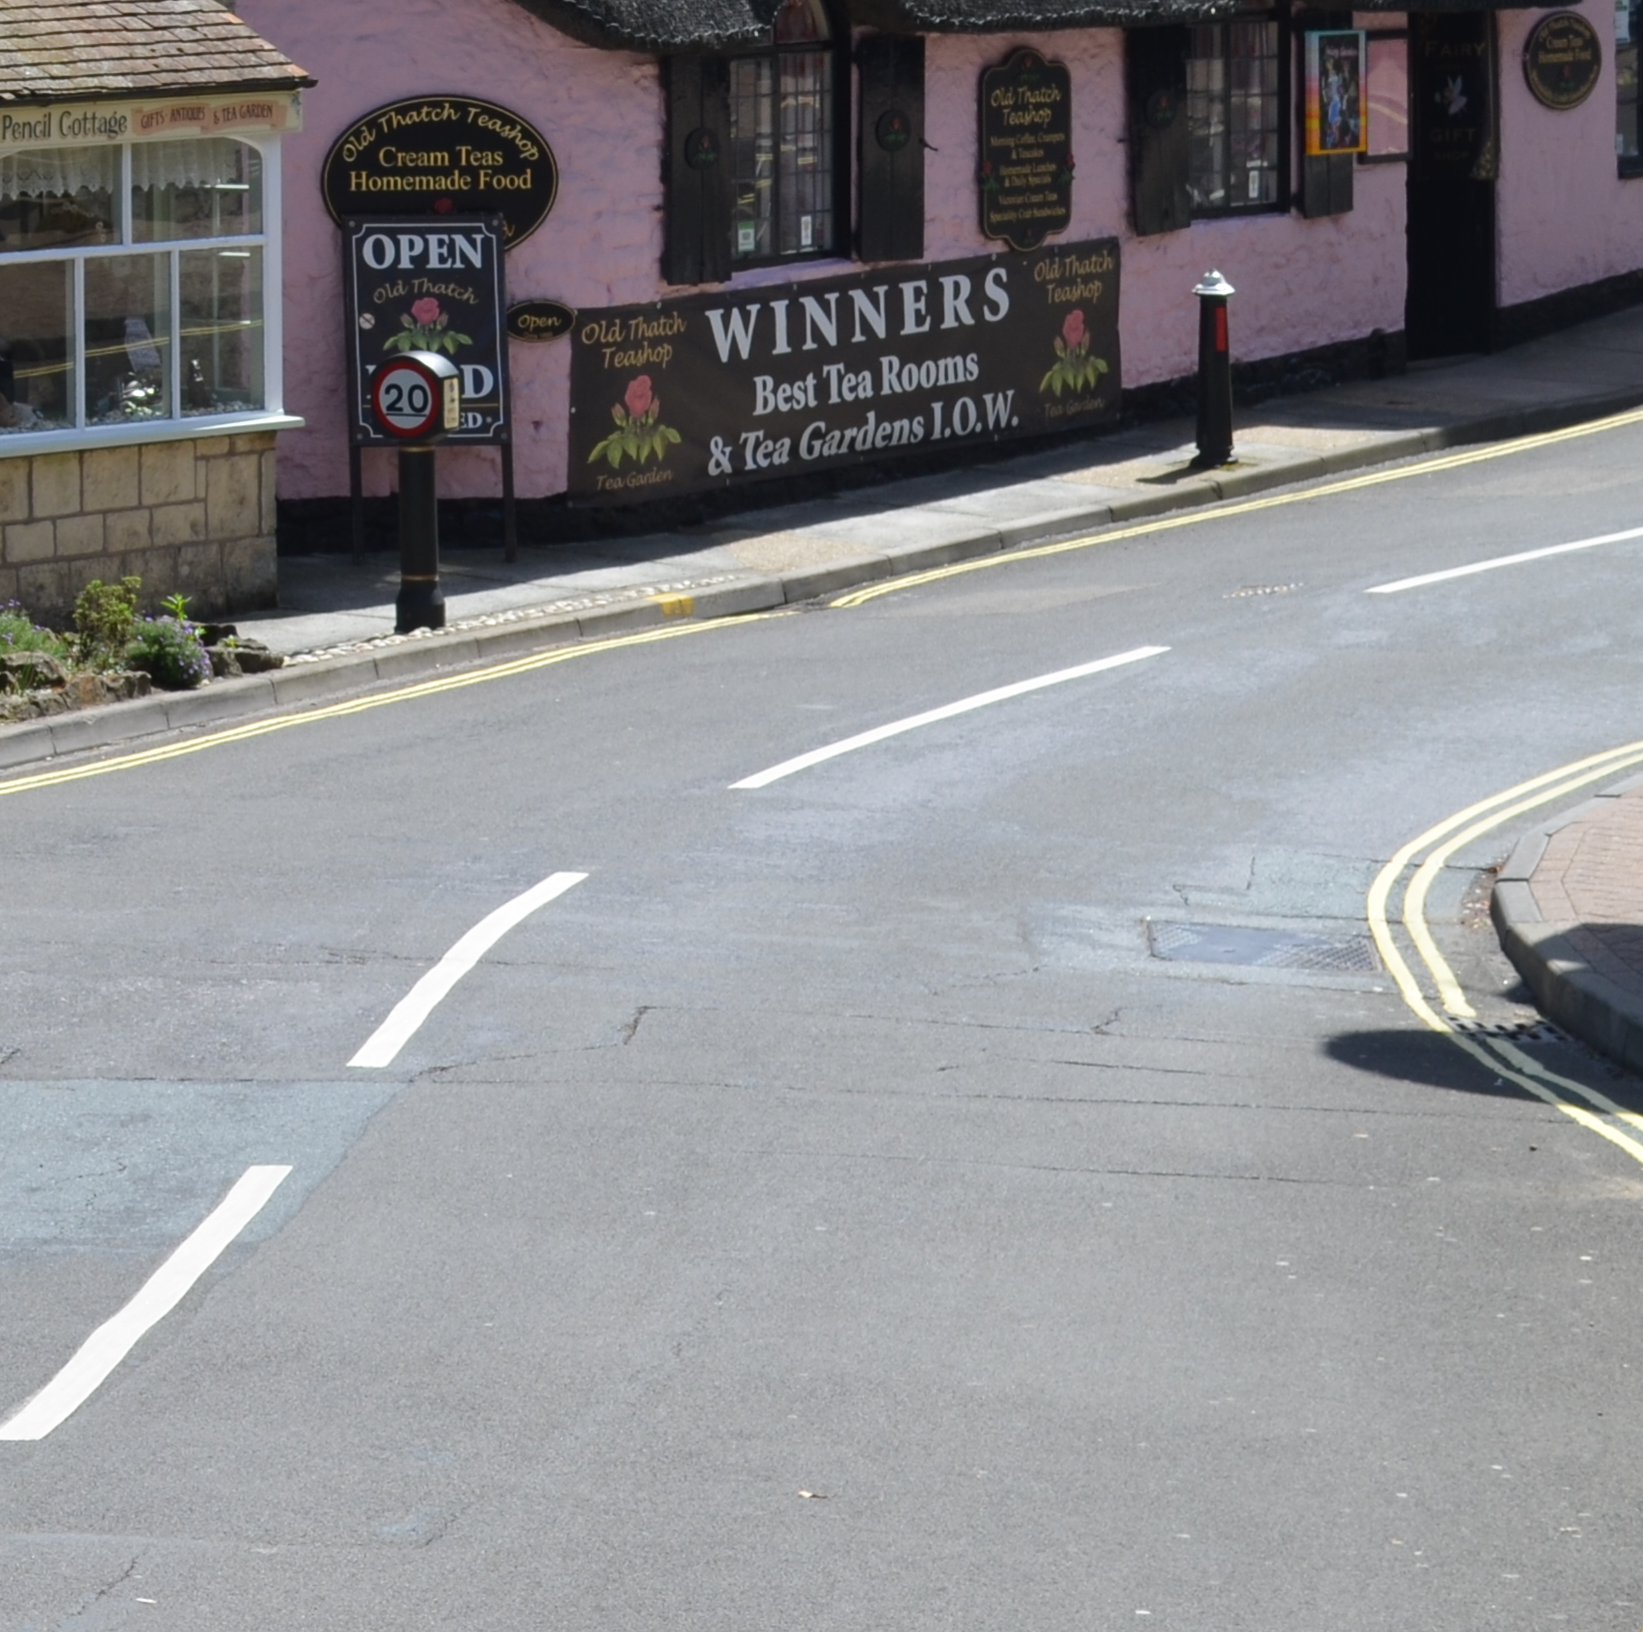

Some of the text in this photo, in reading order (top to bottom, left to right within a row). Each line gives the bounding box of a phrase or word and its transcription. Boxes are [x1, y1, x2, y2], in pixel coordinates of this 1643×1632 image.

[990, 83, 1062, 107] Old Thatch
[1, 111, 128, 141] Pencil Cottage
[140, 103, 273, 130] GIFTS ANTIQUES & TEA GARDEN
[1002, 105, 1052, 128] Teashop
[342, 103, 540, 162] Old Thatch Teashop
[1430, 127, 1476, 143] GIFT
[379, 145, 504, 168] Cream Teas
[349, 169, 532, 192] Homemade Food
[362, 233, 485, 269] OPEN
[1034, 250, 1114, 282] Old Thatch
[373, 277, 480, 304] Old Thatch
[1046, 278, 1102, 304] Teashop
[517, 314, 562, 332] Open
[581, 310, 687, 345] Old Thatch
[705, 267, 1010, 363] WINNERS
[601, 341, 673, 369] Teashop
[752, 351, 980, 416] Best Tea Rooms
[384, 383, 429, 413] 20
[1044, 395, 1105, 417] Tea Garden
[708, 389, 1019, 476] & Tea Gardens I.O.W.
[596, 466, 674, 491] Tea Garden
